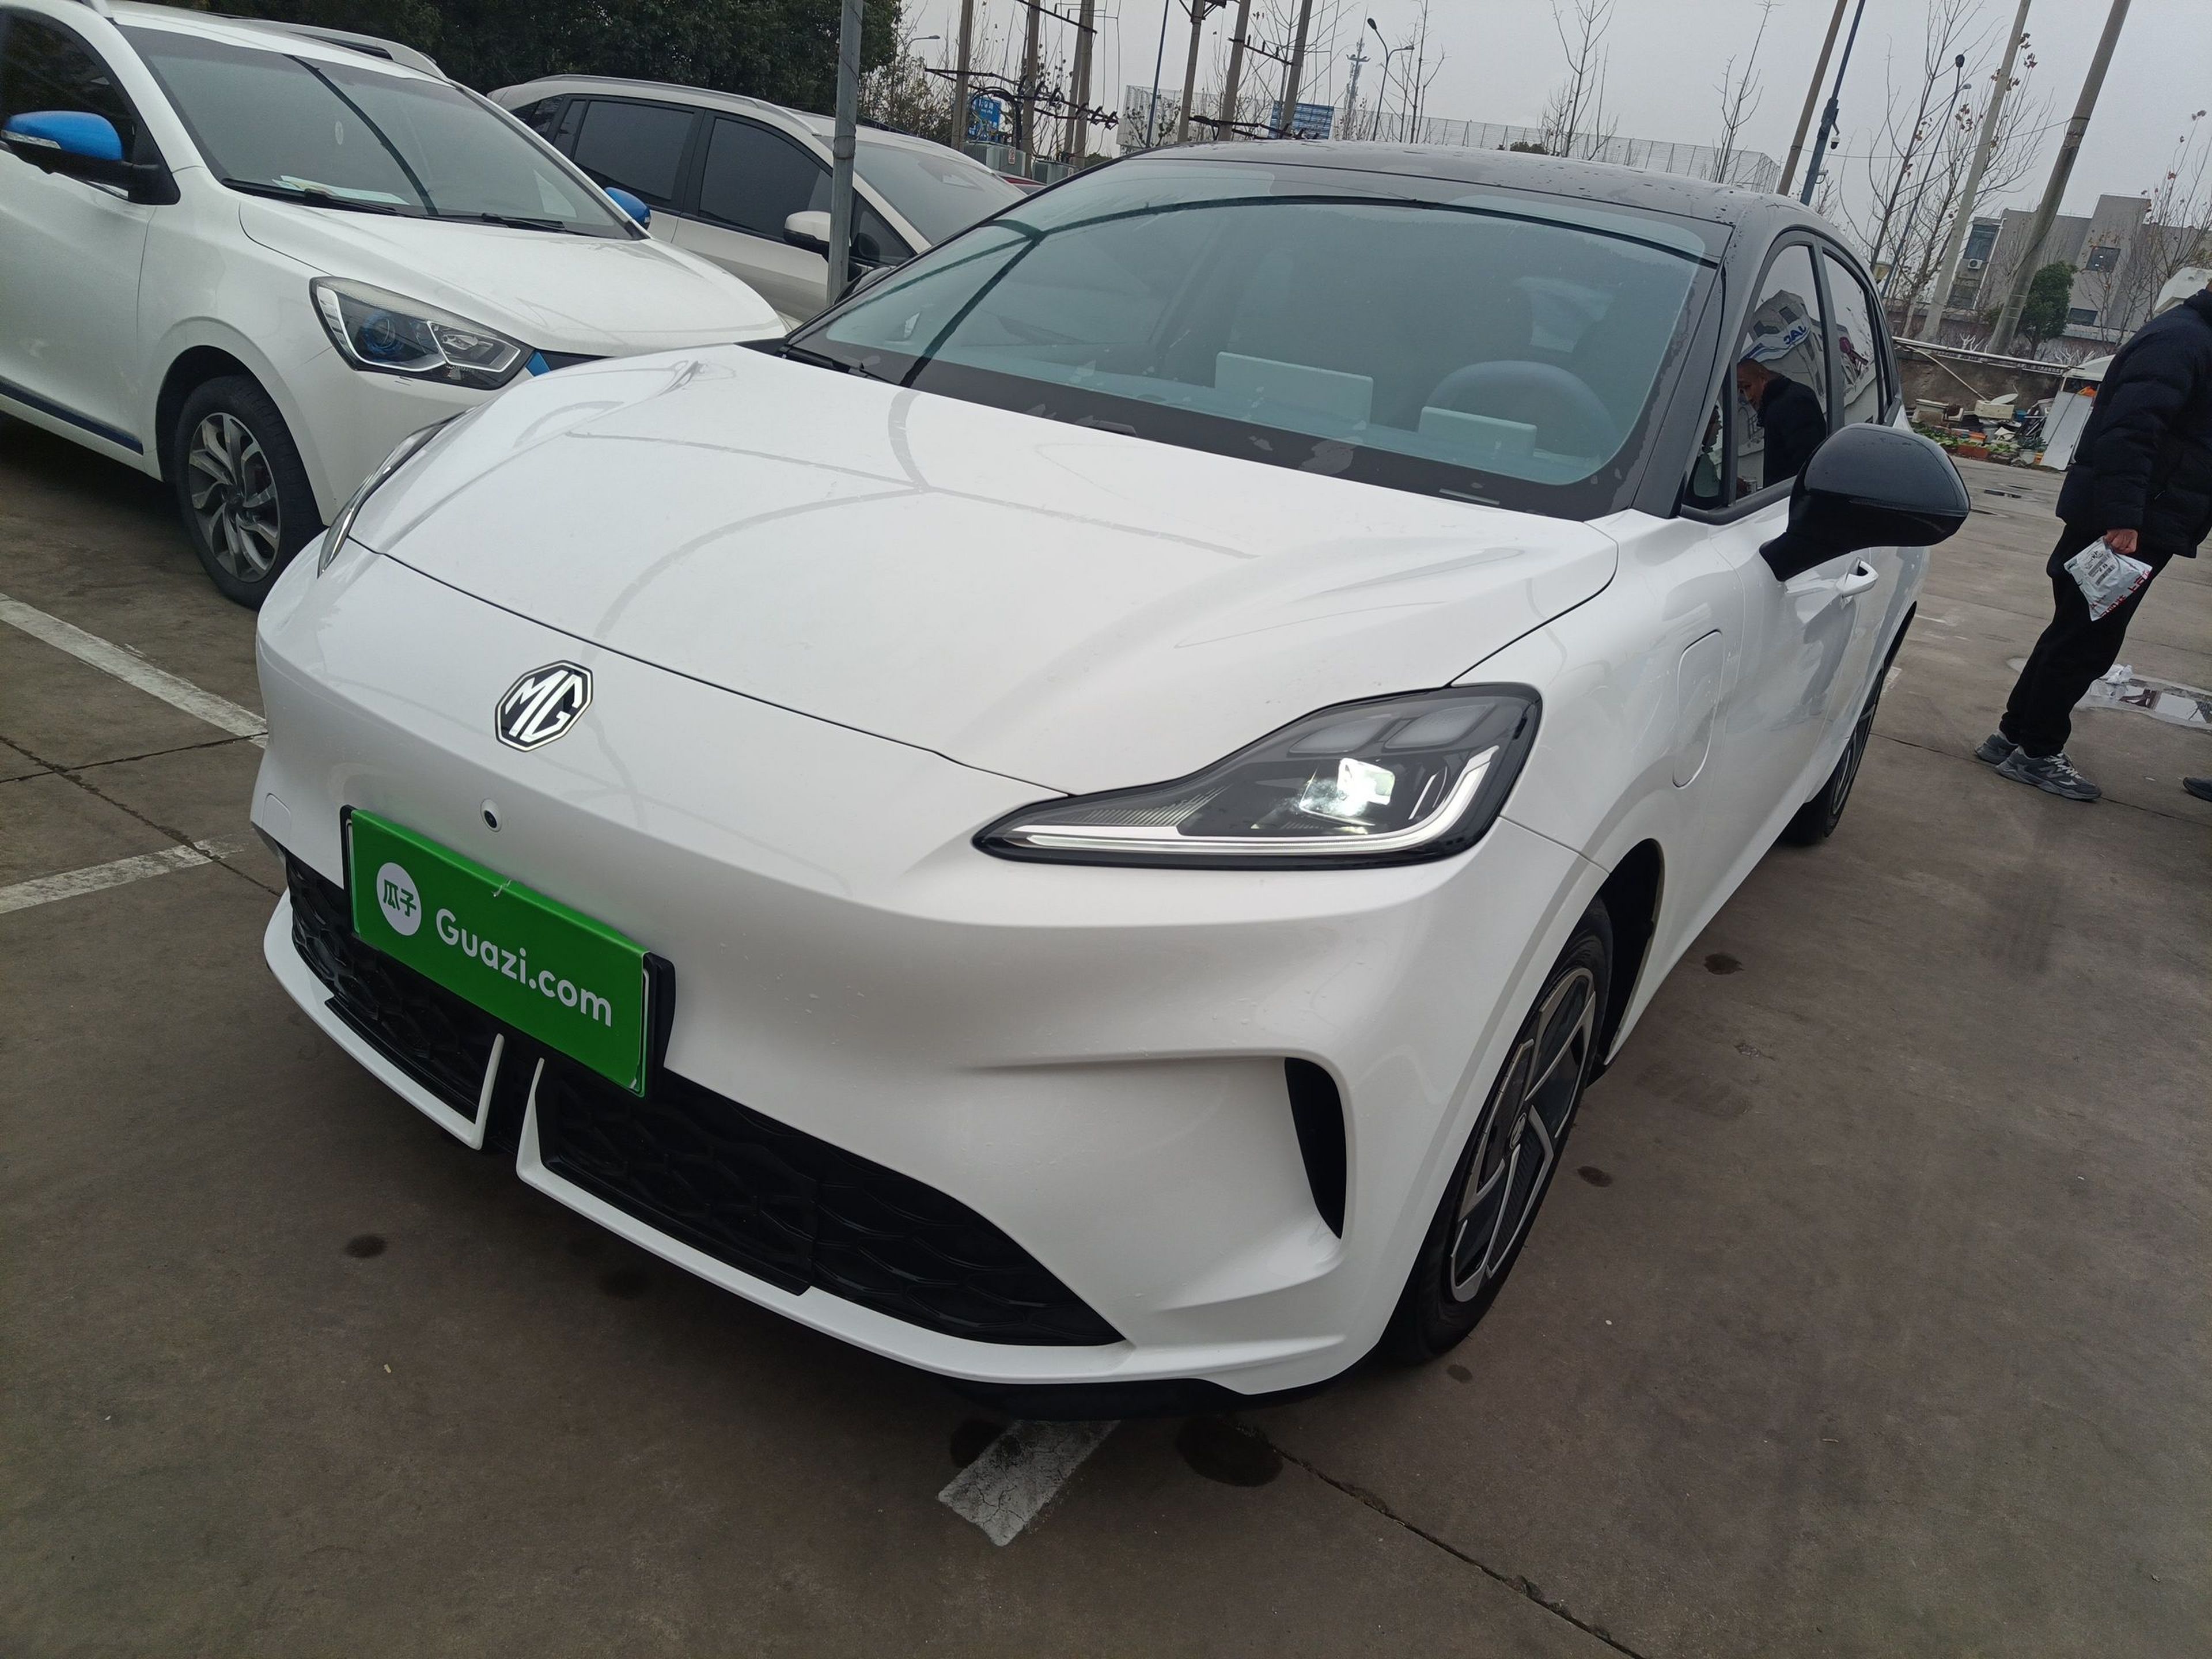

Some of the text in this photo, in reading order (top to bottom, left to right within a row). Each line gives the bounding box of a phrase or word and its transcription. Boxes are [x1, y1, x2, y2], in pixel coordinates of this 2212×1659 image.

[505, 669, 582, 743] MG
[383, 878, 417, 917] 瓜子
[435, 908, 612, 1027] Guazi.com
